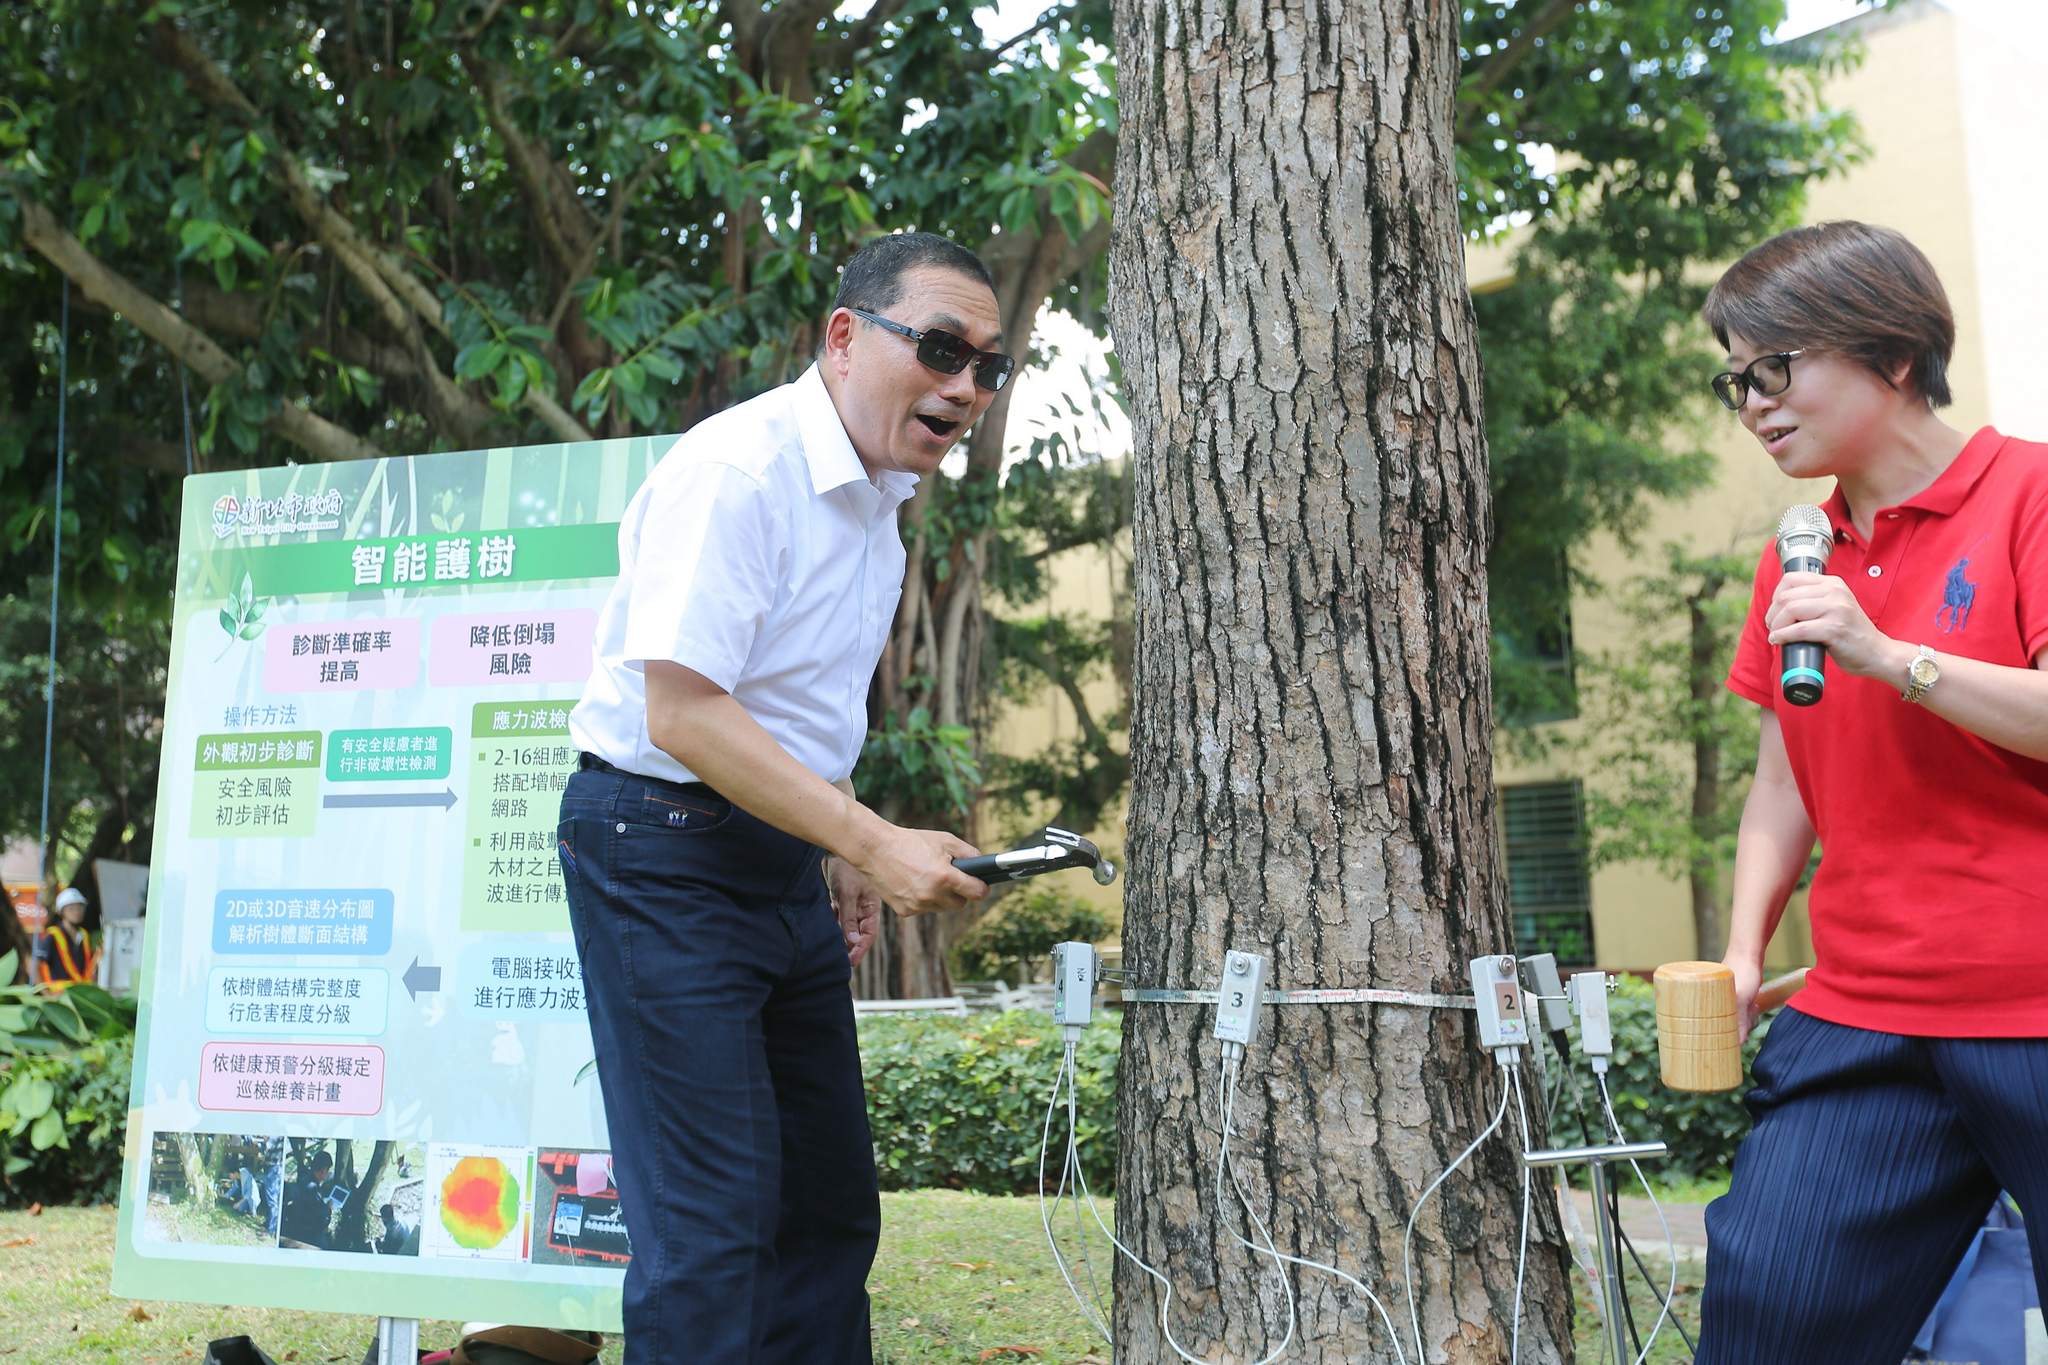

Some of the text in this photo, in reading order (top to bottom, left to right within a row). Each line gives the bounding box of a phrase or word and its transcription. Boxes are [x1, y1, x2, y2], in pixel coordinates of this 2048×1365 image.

[240, 489, 342, 524] 新北市政府
[351, 535, 516, 586] 智能護樹
[292, 631, 391, 656] 診斷準確率
[470, 623, 555, 648] 降低倒塌
[320, 660, 359, 683] 提高
[489, 653, 532, 675] 風險
[224, 704, 297, 727] 操作方法
[203, 740, 314, 764] 外觀初步診斷
[341, 736, 438, 753] 有安全疑慮者進
[340, 755, 436, 773] 行非破壞性檢測
[218, 776, 292, 799] 安全風險
[493, 772, 567, 792] 搭配增幅
[216, 804, 290, 826] 初步評估
[491, 798, 528, 818] 網路
[489, 857, 561, 878] 木材之自
[487, 883, 567, 904] 波進行傳
[225, 899, 374, 920] 2D或3D音速分布圖
[228, 924, 368, 945] 解析樹體斷面結構
[492, 957, 582, 980] 電腦接收
[223, 977, 361, 999] 依樹體結構完整度
[1058, 978, 1064, 994] 4
[1231, 991, 1243, 1008] 3
[1504, 994, 1515, 1010] 2
[229, 1002, 350, 1024] 行危害程度分級
[212, 1053, 371, 1077] 依健康預警分級擬定
[236, 1080, 342, 1102] 巡檢維養計畫
